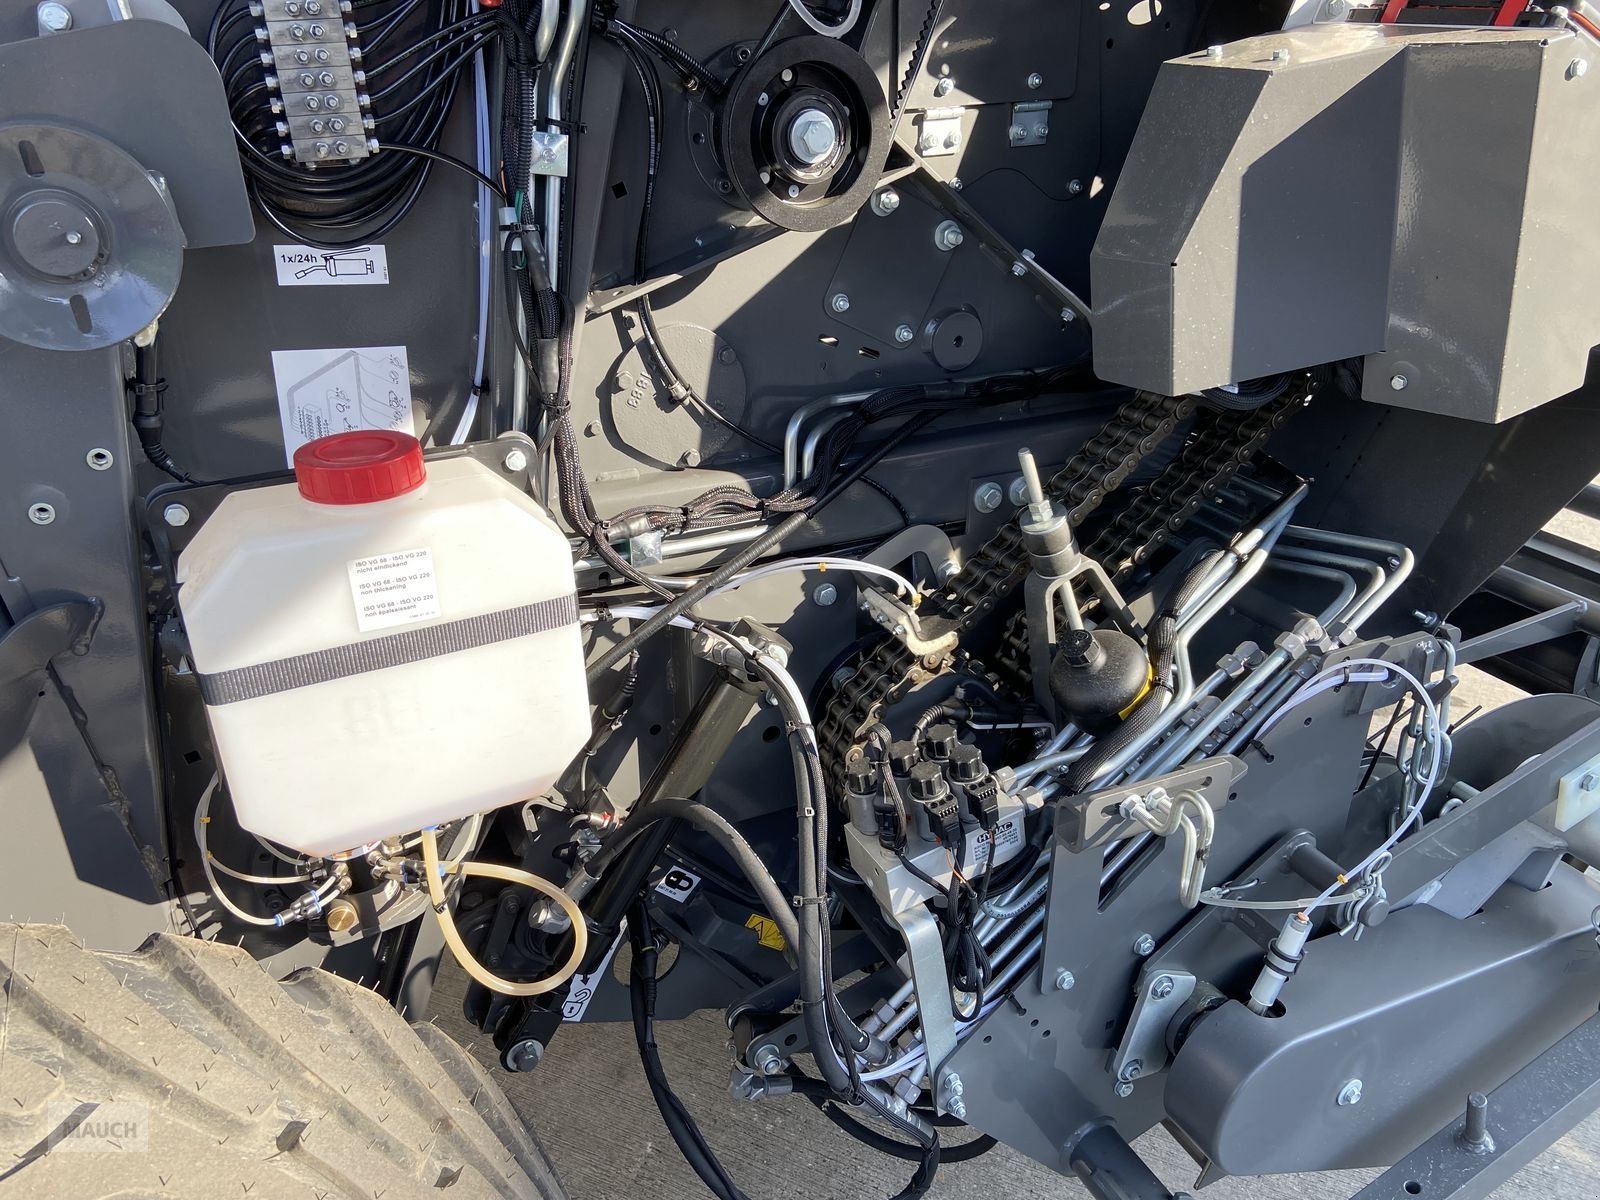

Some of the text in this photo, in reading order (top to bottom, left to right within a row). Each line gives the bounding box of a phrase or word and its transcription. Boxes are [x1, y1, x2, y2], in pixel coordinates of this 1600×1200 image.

[281, 254, 318, 263] 1x/24h
[374, 561, 408, 571] eindickend
[374, 583, 406, 593] thickening
[978, 822, 1011, 842] HYAC
